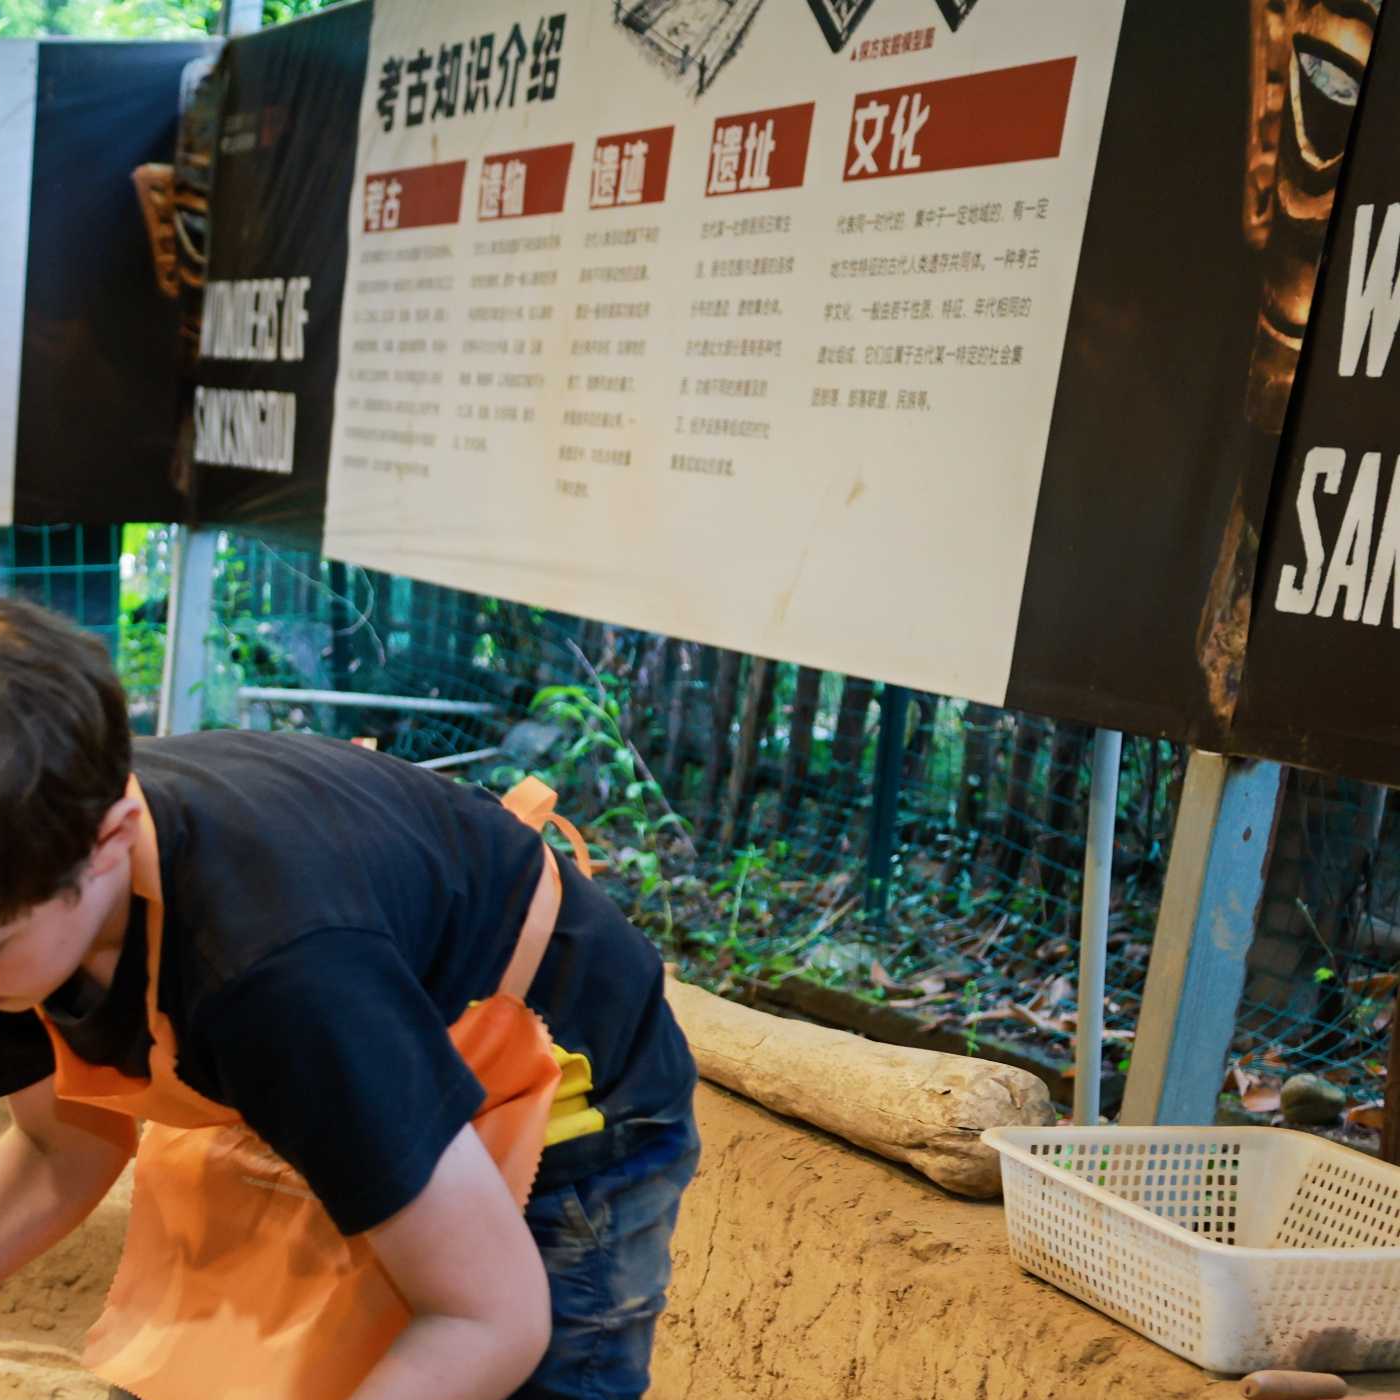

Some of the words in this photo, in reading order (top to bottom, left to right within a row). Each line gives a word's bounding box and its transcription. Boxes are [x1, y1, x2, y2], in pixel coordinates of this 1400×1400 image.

[376, 13, 567, 132] 考古知识介绍
[708, 118, 776, 194] 遗址
[848, 92, 931, 176] 文化
[366, 177, 403, 231] 考古
[281, 276, 311, 361] OF
